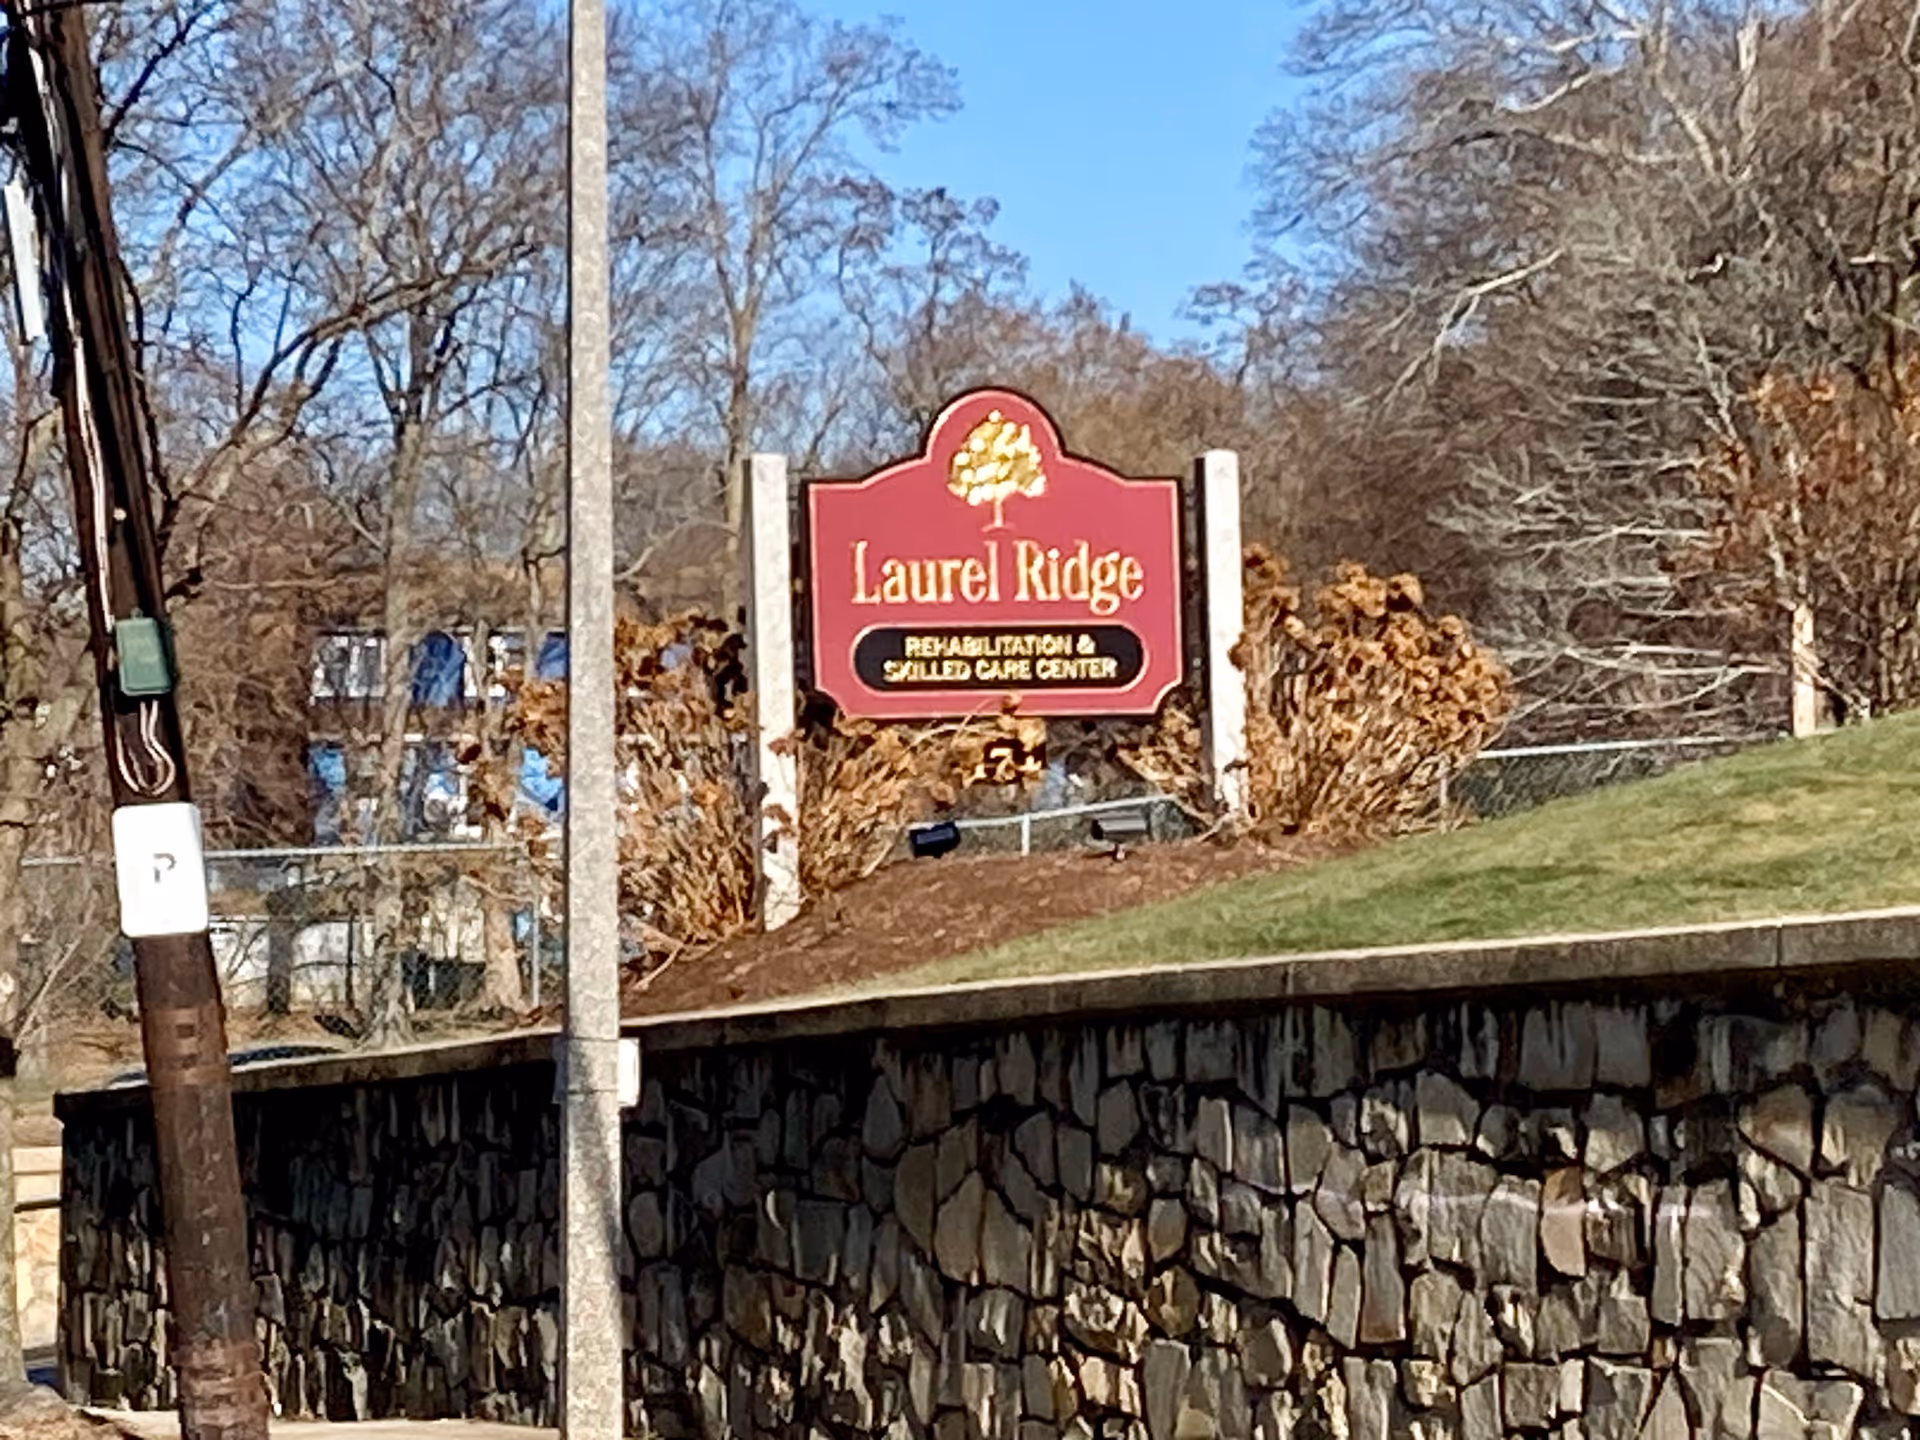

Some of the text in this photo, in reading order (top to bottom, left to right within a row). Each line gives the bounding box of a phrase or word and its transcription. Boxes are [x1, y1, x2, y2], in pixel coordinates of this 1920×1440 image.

[850, 539, 1144, 616] Laurel Ridge
[904, 633, 1096, 657] REHABILITATION &
[883, 657, 1118, 682] SKILLED CARE CENTER
